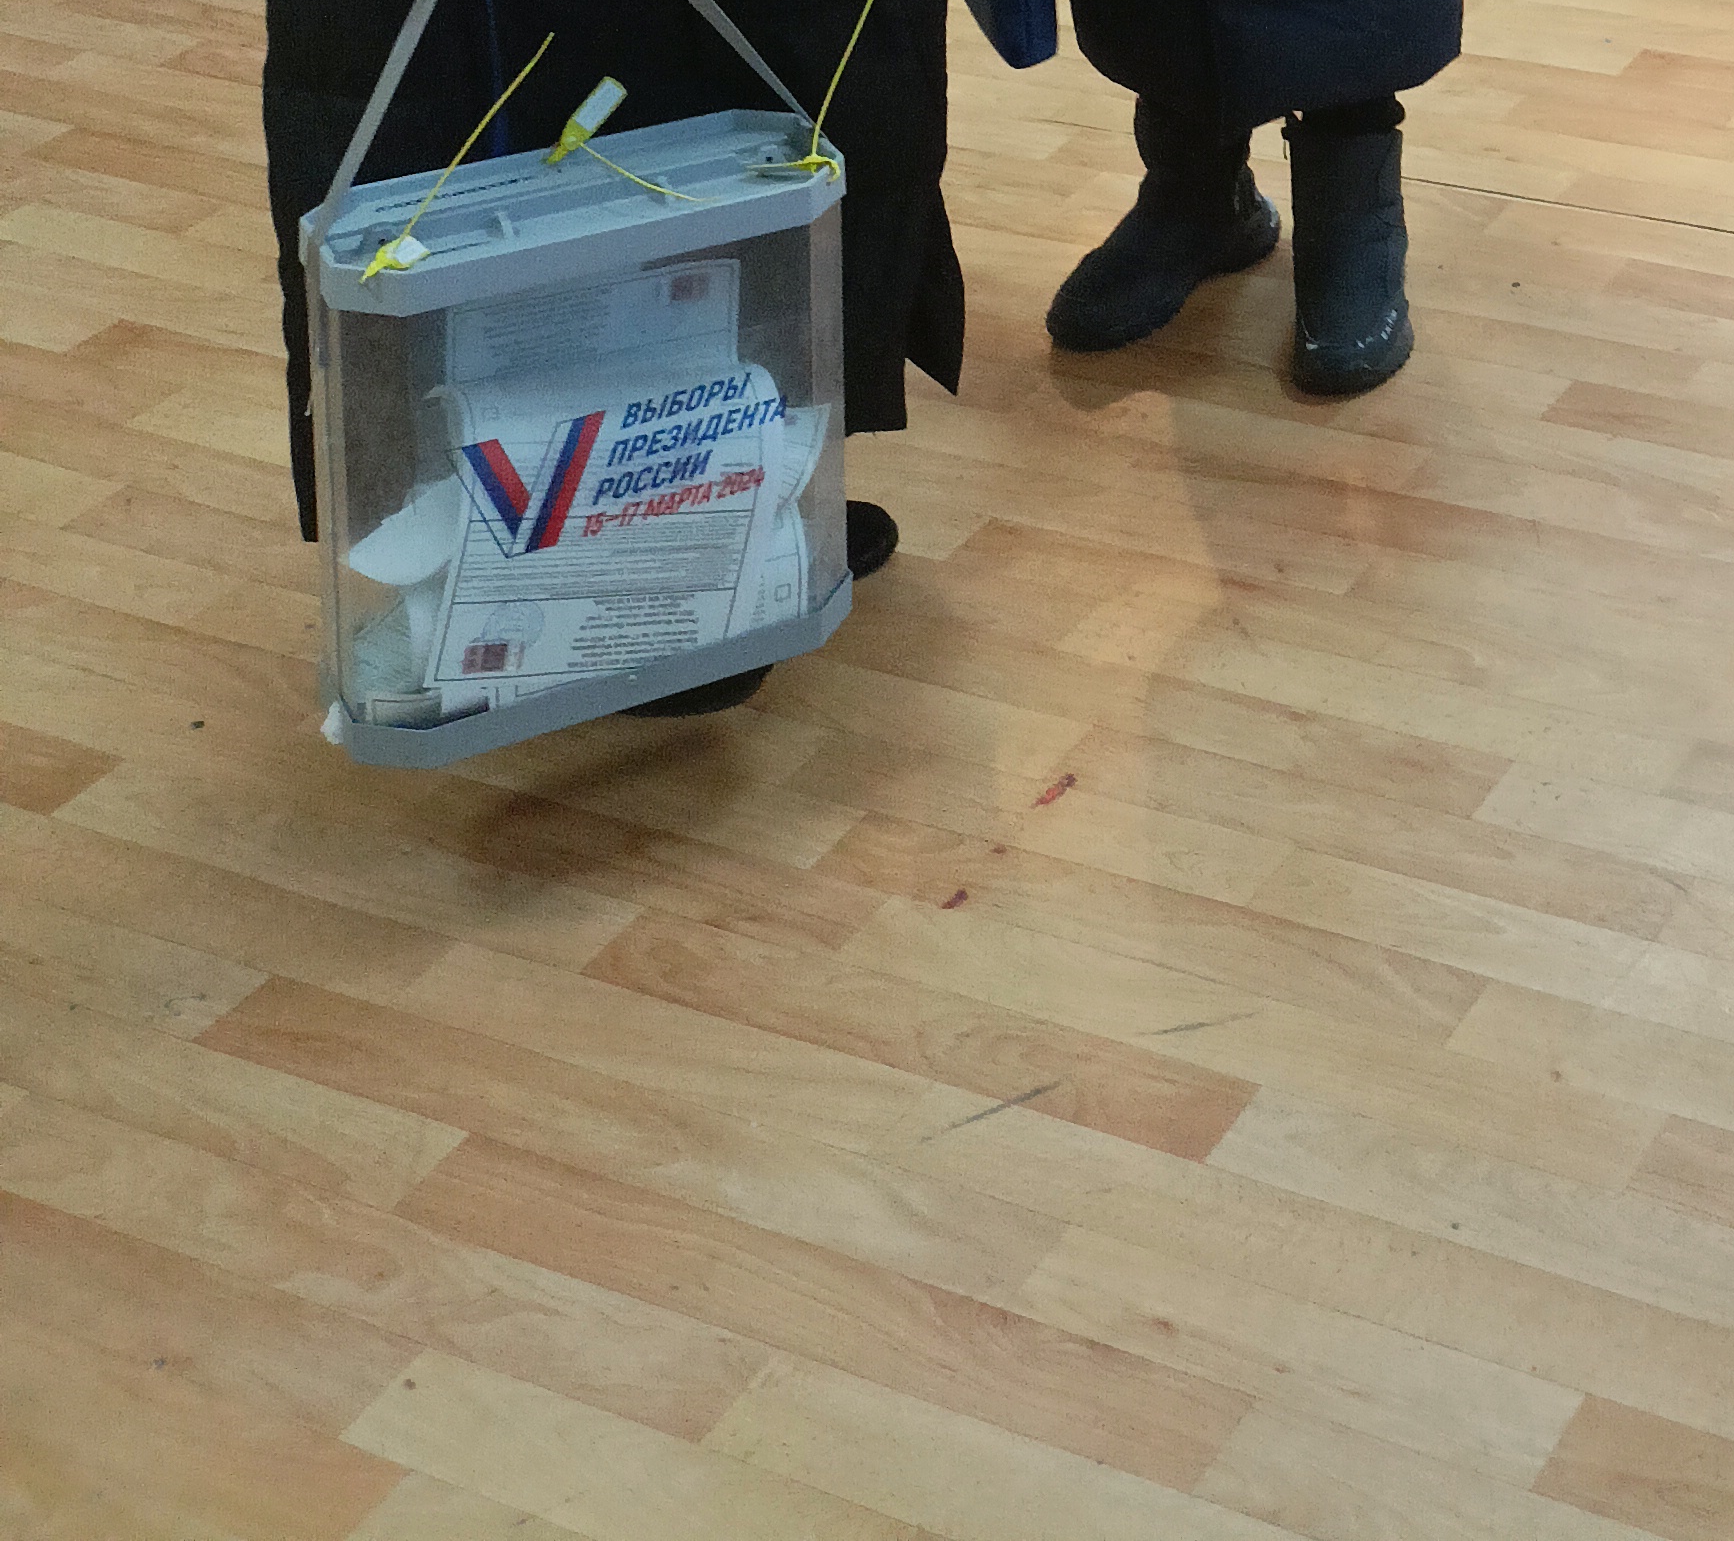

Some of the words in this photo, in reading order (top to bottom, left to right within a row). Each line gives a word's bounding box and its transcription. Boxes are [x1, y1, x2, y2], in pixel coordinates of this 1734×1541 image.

[606, 394, 788, 467] ПРЕЗИДЕНТА
[620, 372, 752, 431] ВЫБОРЫ
[592, 449, 714, 506] РОССИИ
[643, 481, 713, 520] МАРТА
